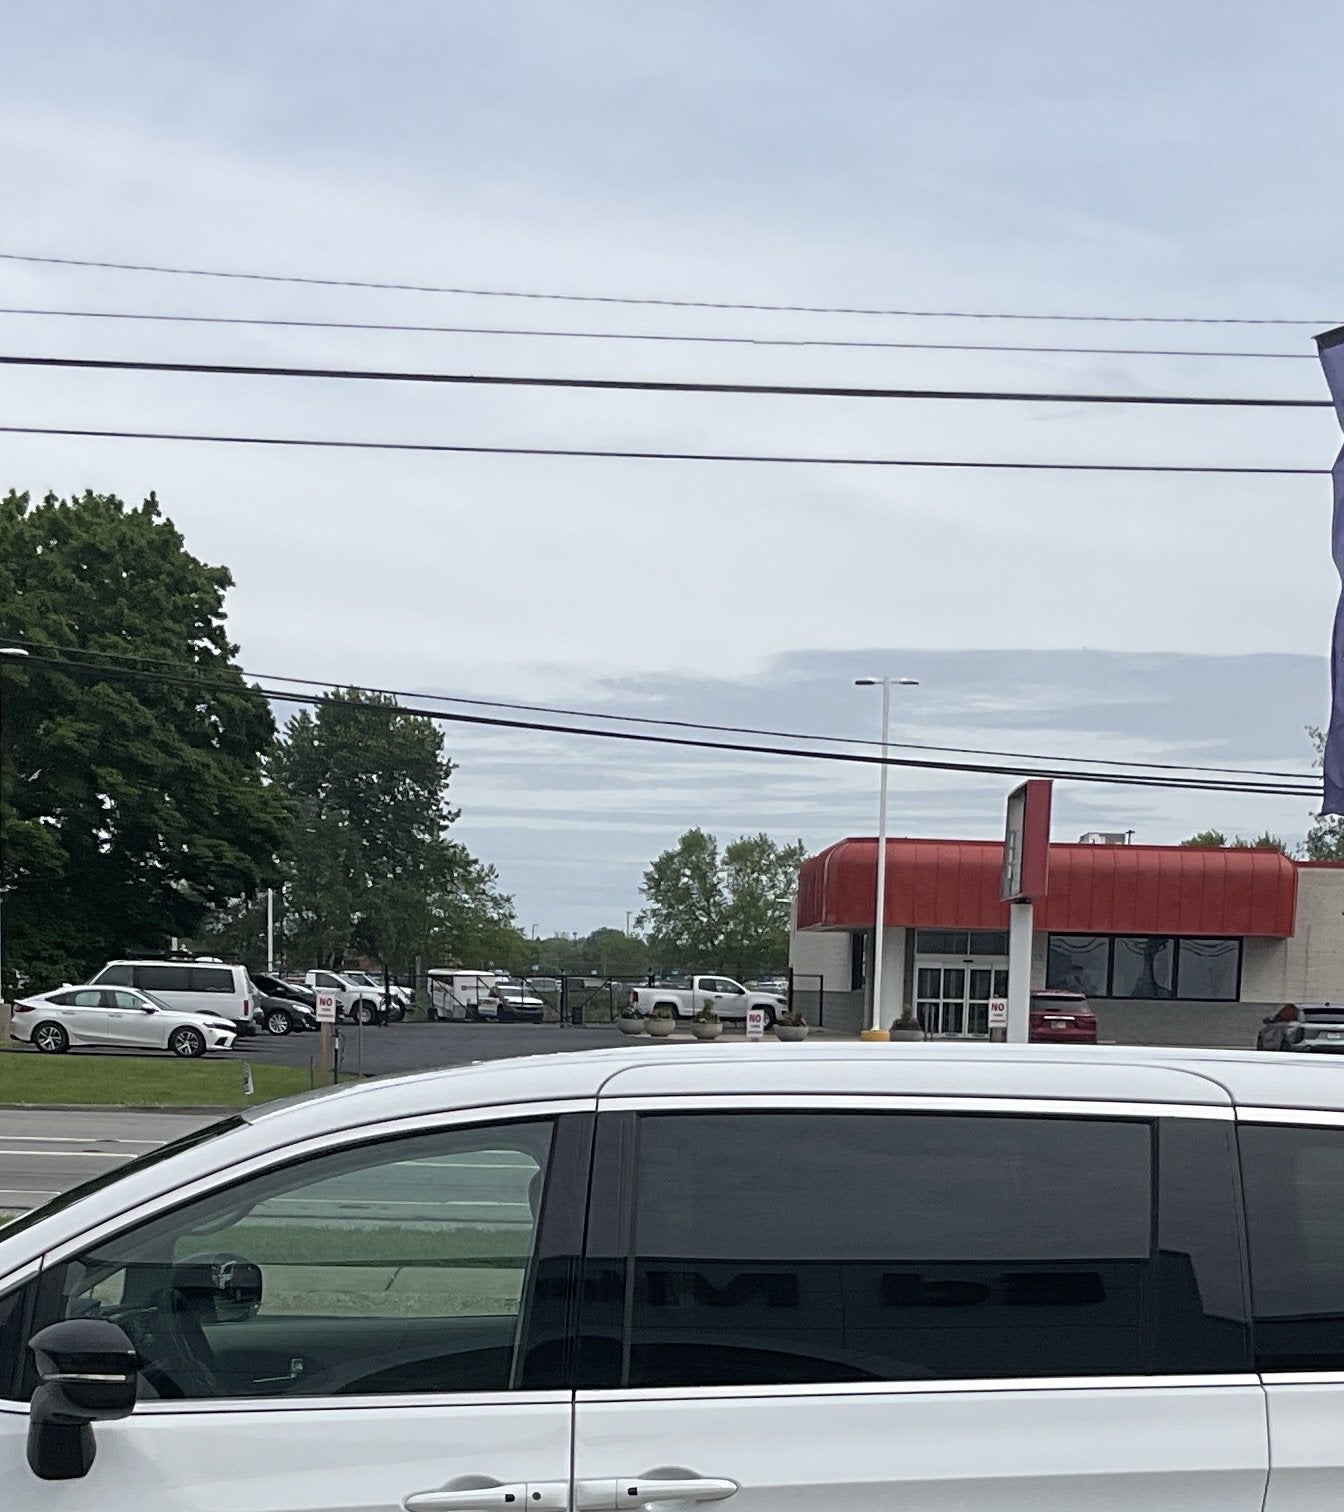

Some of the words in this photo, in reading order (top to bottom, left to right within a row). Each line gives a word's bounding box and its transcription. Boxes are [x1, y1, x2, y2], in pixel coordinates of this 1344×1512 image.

[319, 997, 333, 1006] NO
[991, 1002, 1005, 1012] NO
[749, 1014, 761, 1023] NO
